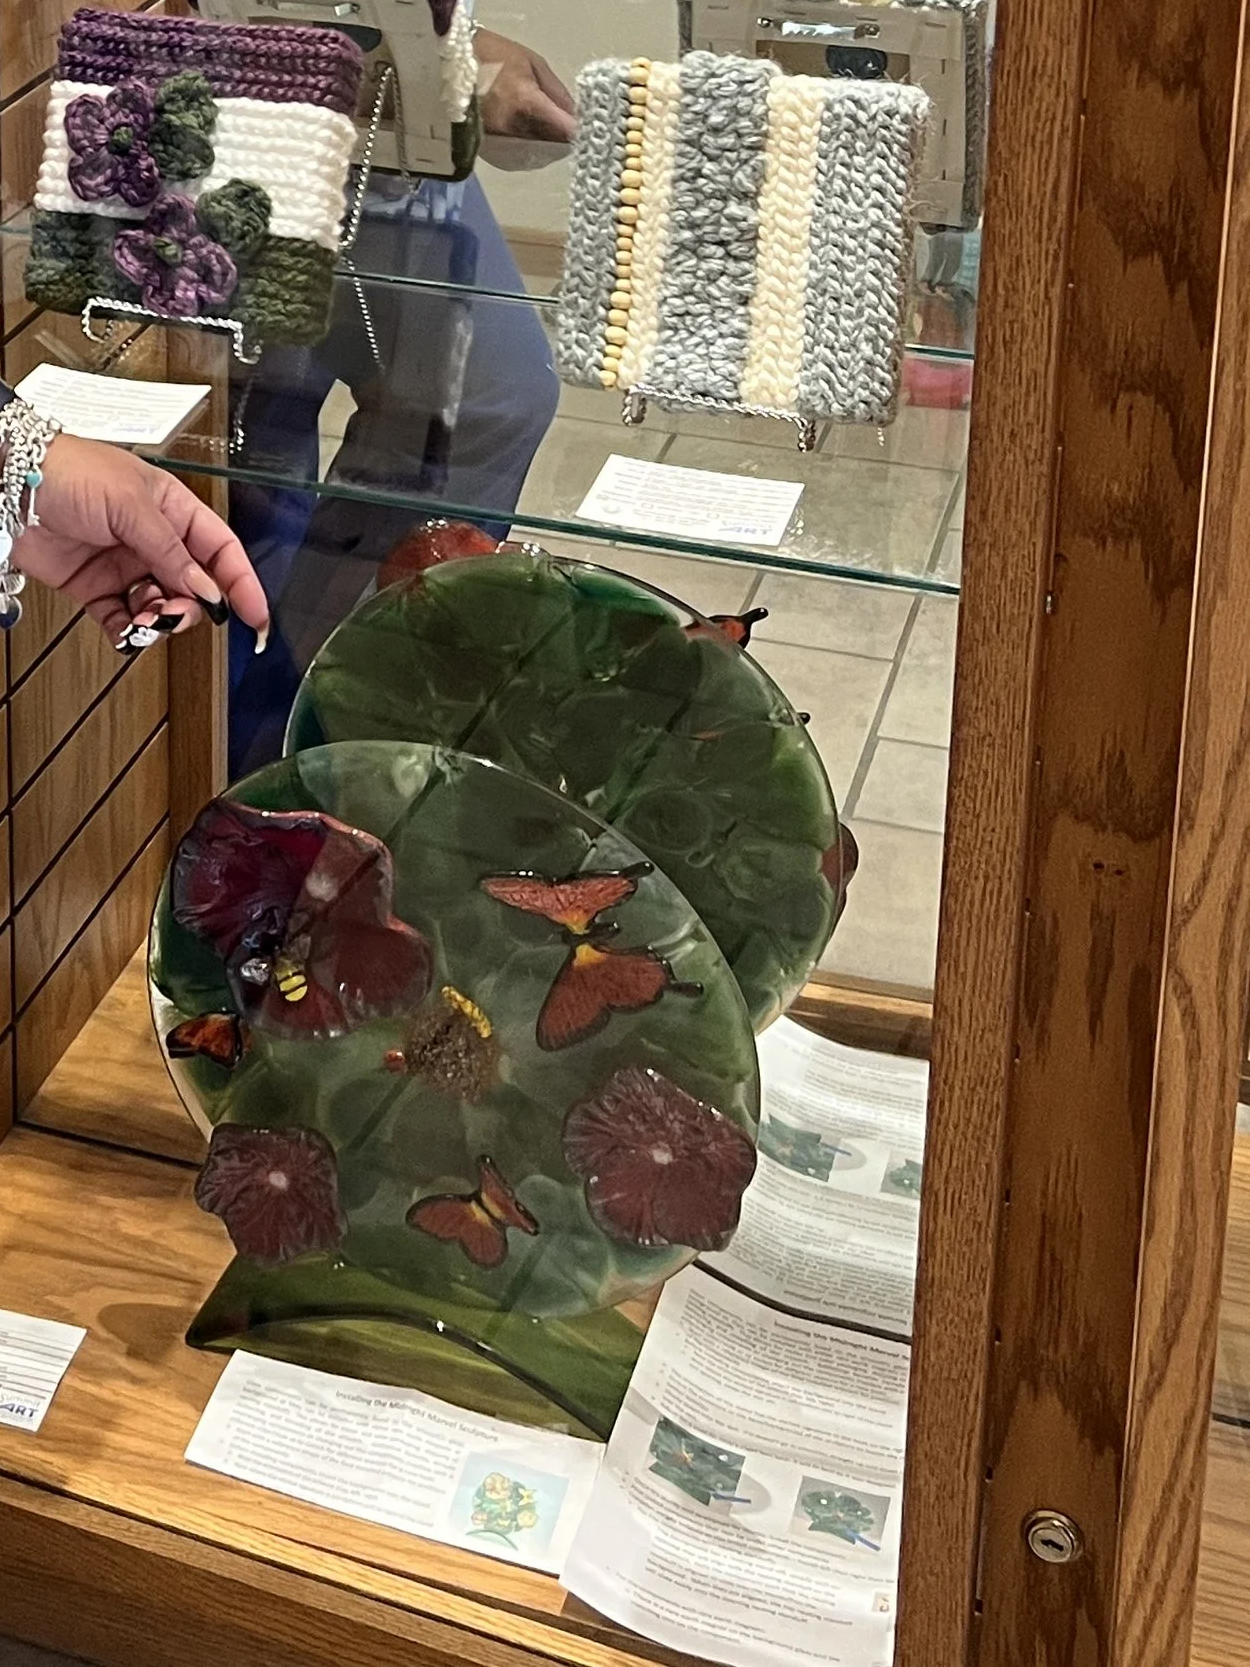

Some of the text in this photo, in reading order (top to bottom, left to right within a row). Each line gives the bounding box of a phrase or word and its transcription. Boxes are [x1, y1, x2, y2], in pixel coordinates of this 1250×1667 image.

[335, 1390, 372, 1406] Installing
[374, 1399, 388, 1408] the
[389, 1401, 426, 1418] Midnight
[427, 1413, 458, 1429] Marvel
